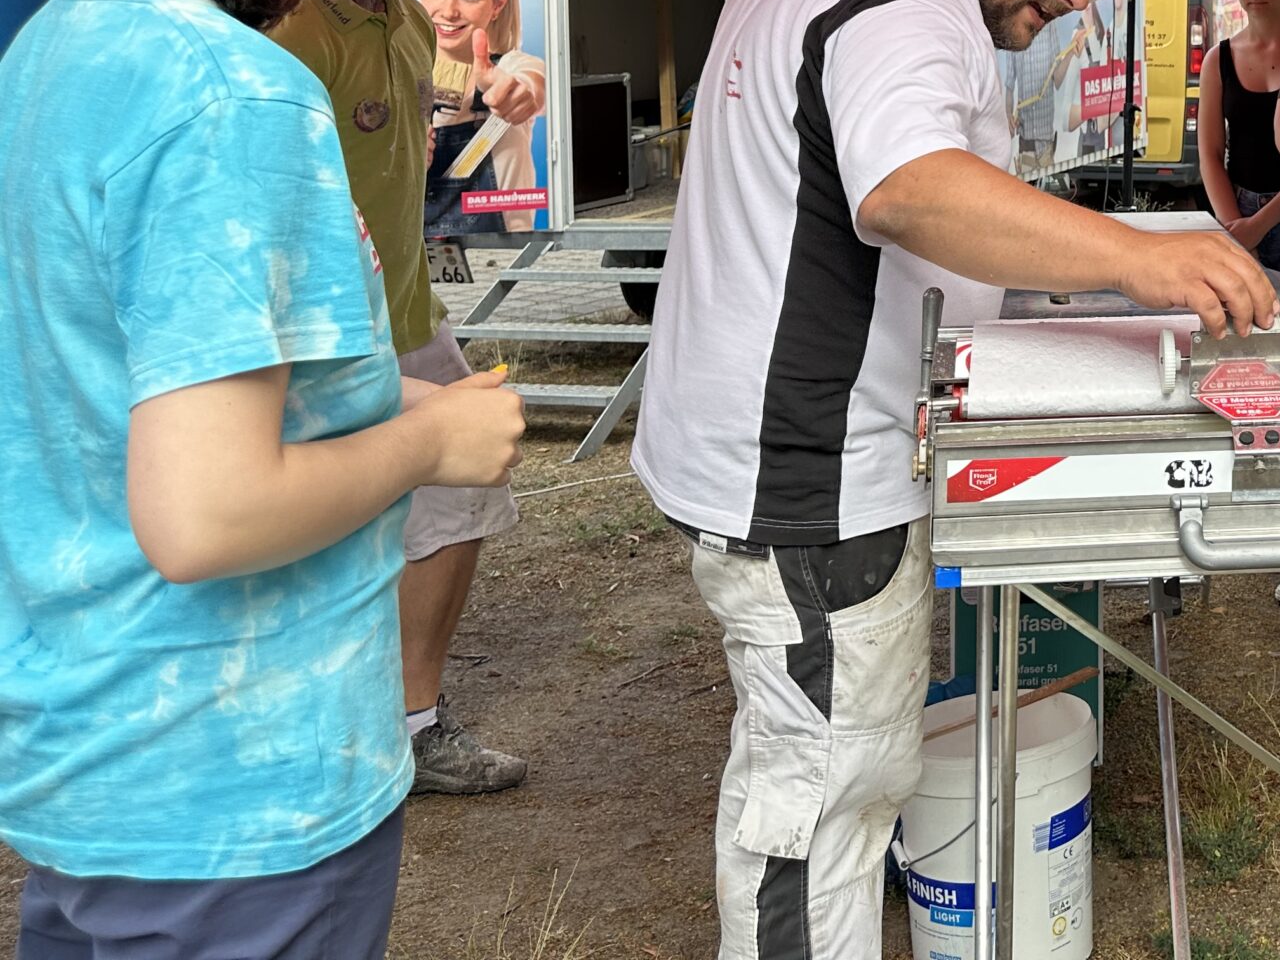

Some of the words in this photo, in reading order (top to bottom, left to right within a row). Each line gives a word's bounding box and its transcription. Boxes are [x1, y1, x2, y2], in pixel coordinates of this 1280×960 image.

[1084, 79, 1100, 96] DAS
[467, 196, 488, 206] DAS
[431, 266, 465, 283] 66
[1047, 664, 1058, 673] 51
[911, 877, 957, 906] FINISH
[934, 910, 961, 923] LIGHT
